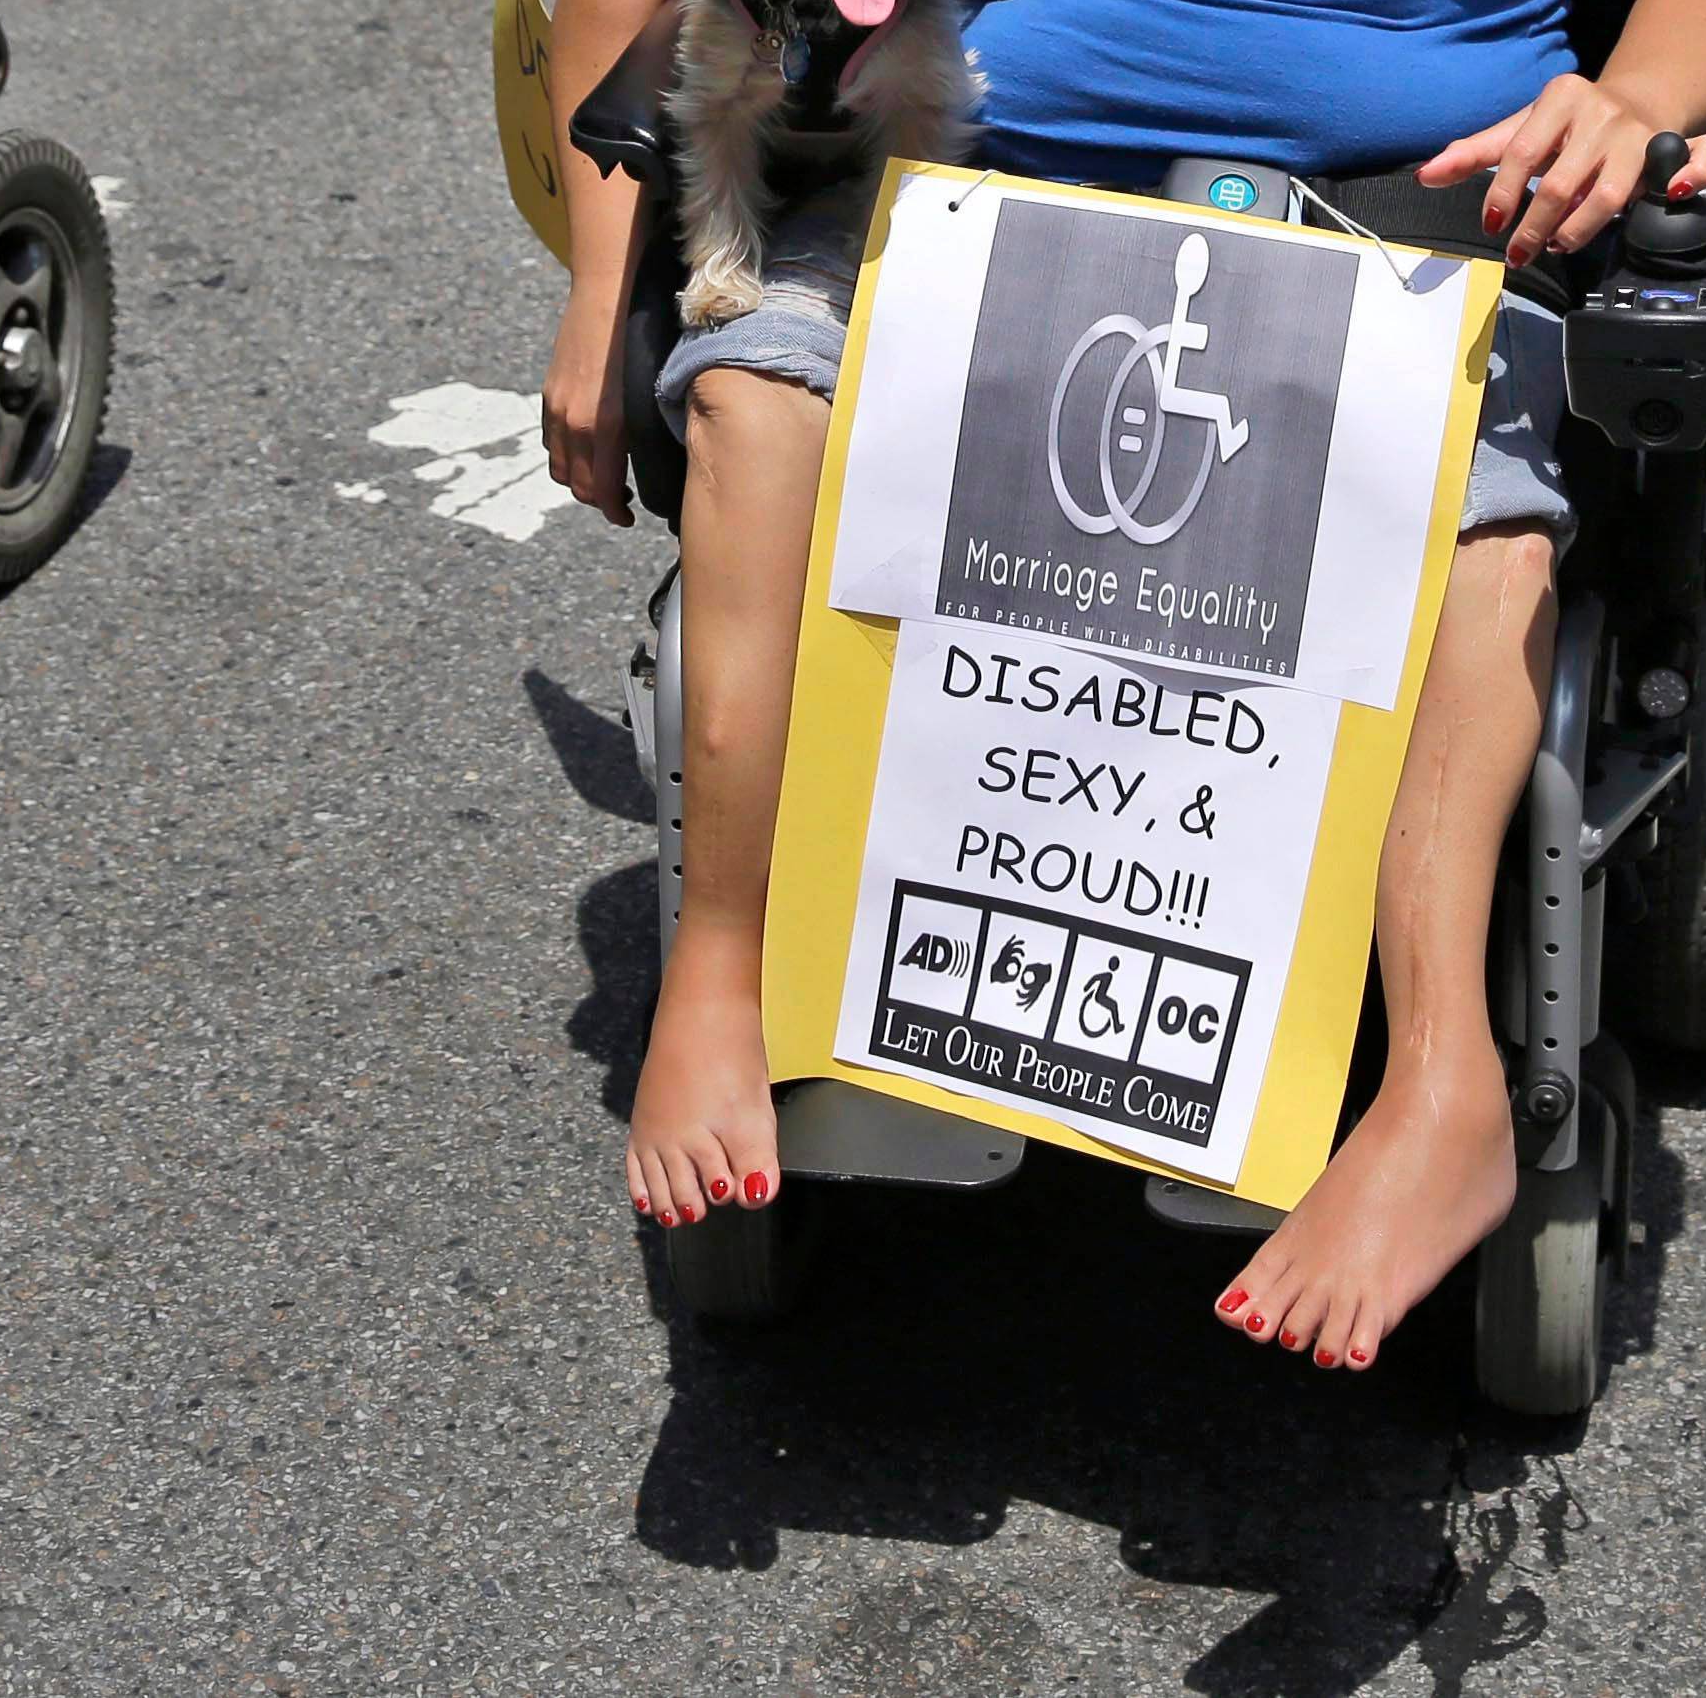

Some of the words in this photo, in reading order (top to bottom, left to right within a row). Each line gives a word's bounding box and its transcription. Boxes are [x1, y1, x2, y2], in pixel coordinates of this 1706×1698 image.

[944, 602, 980, 619] FOR
[995, 610, 1069, 635] PEOPLE
[1084, 626, 1130, 647] WITH
[1144, 638, 1287, 675] DISABILITIES
[964, 537, 1118, 612] Marriage
[1136, 567, 1277, 646] Equality
[942, 644, 1280, 769] DISABLED,
[978, 747, 1157, 833] SEXY,
[1179, 784, 1215, 839] &
[956, 825, 1210, 929] PROUD!!!
[1157, 995, 1220, 1044] OC
